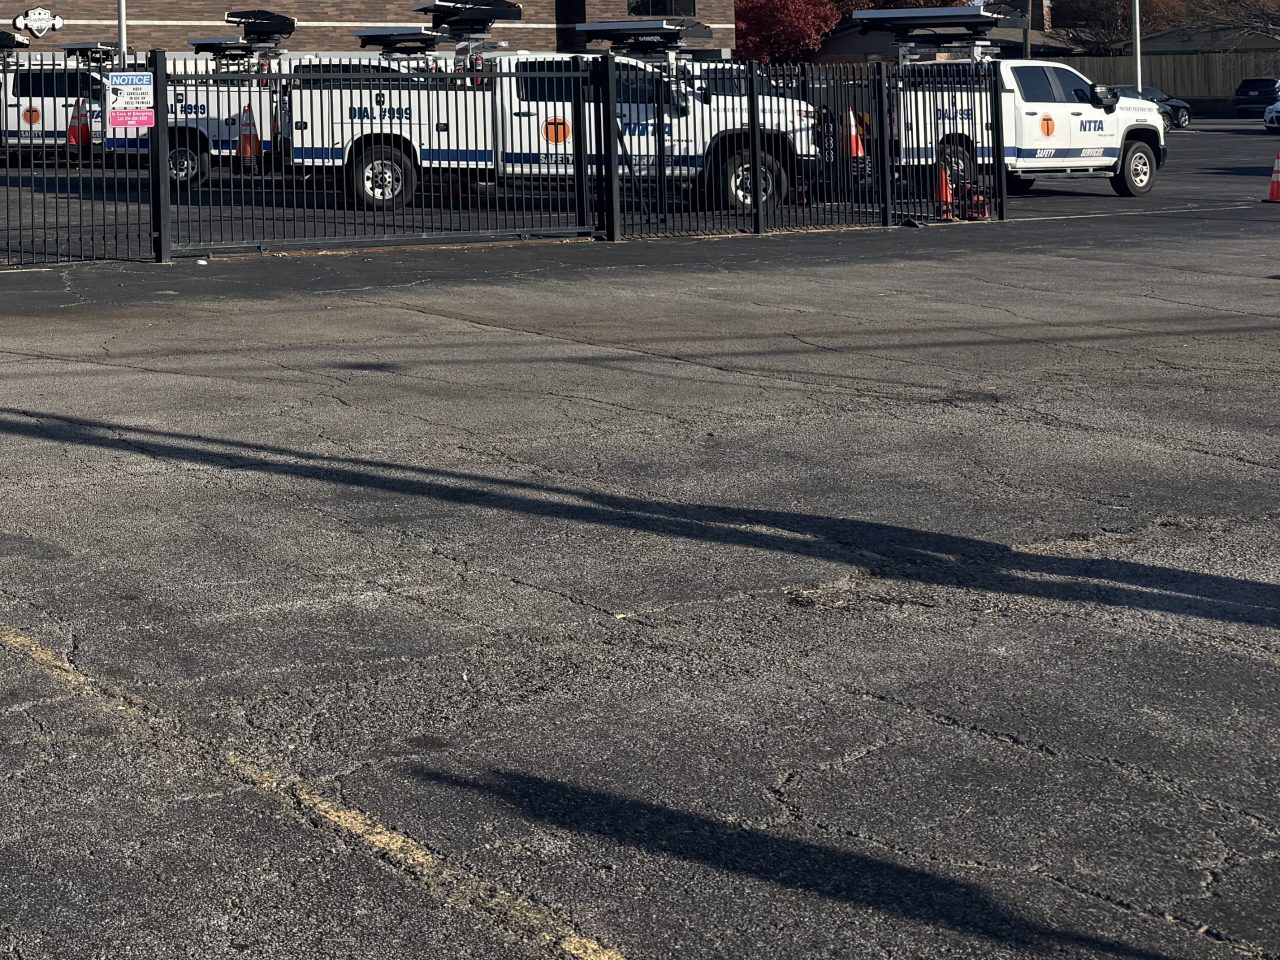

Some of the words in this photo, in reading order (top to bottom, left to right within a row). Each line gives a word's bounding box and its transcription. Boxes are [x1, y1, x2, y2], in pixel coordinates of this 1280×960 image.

[112, 76, 150, 84] NOTICE
[180, 104, 206, 115] #999
[349, 106, 376, 120] DIAL
[379, 107, 412, 120] #999
[1080, 120, 1104, 132] NTTA
[1035, 149, 1055, 157] SAFETY
